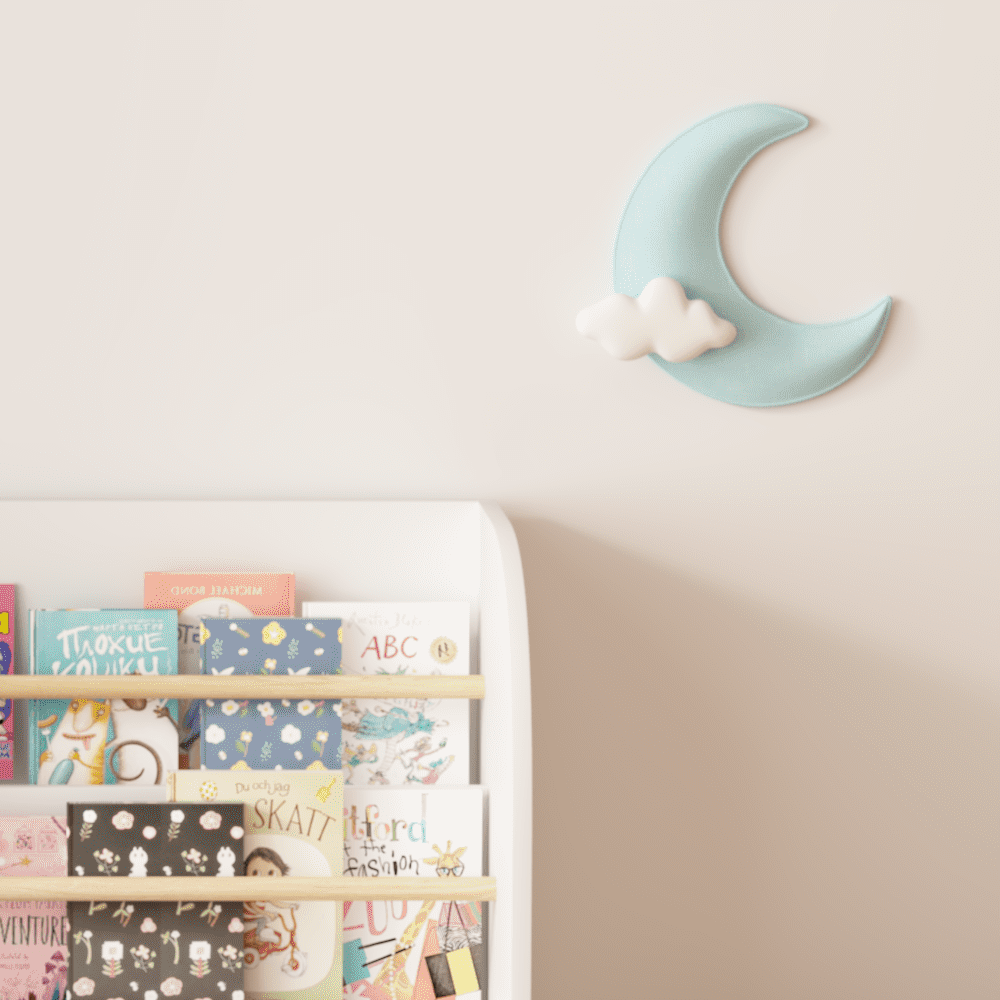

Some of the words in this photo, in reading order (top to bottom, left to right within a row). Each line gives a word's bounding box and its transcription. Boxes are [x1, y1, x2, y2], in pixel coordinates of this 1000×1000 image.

[360, 634, 419, 661] ABC
[252, 797, 337, 842] SKATT
[343, 850, 420, 877] fashion
